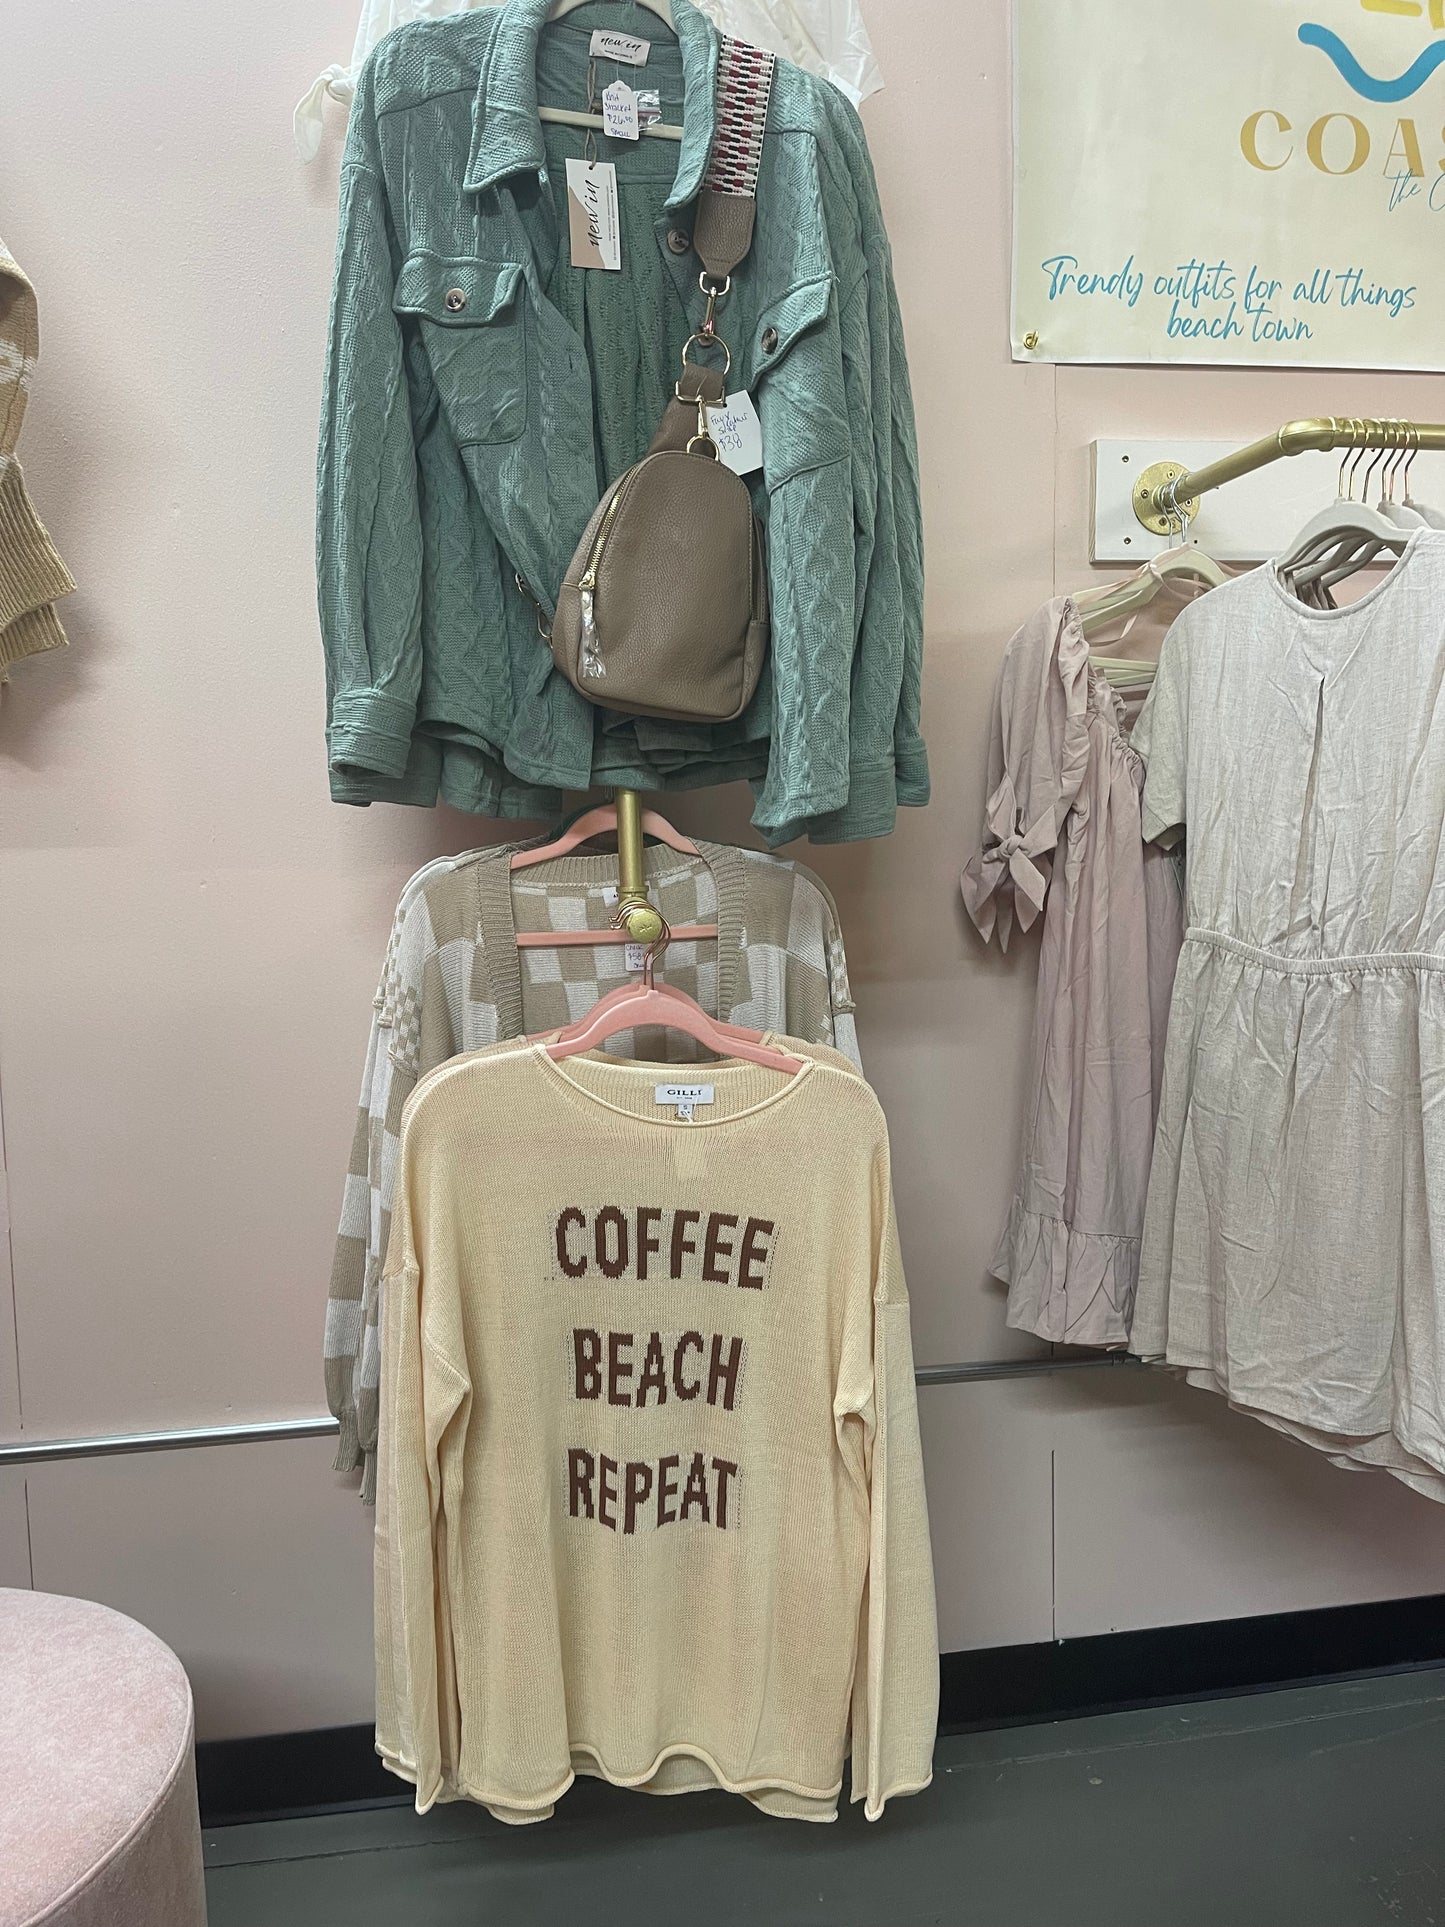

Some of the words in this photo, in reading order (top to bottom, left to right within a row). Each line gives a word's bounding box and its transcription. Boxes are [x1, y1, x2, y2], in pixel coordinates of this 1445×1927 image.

[1240, 110, 1445, 178] COA
[584, 179, 600, 203] in
[584, 201, 603, 247] new
[1042, 255, 1143, 307] Trendy
[1153, 258, 1236, 308] outfits
[1245, 265, 1282, 309] for
[1293, 268, 1334, 304] all
[1335, 267, 1417, 317] things
[1167, 300, 1244, 340] beach
[1246, 302, 1313, 342] town
[556, 1206, 775, 1290] COFFEE
[573, 1328, 743, 1411] BEACH
[568, 1448, 738, 1534] REPEAT
